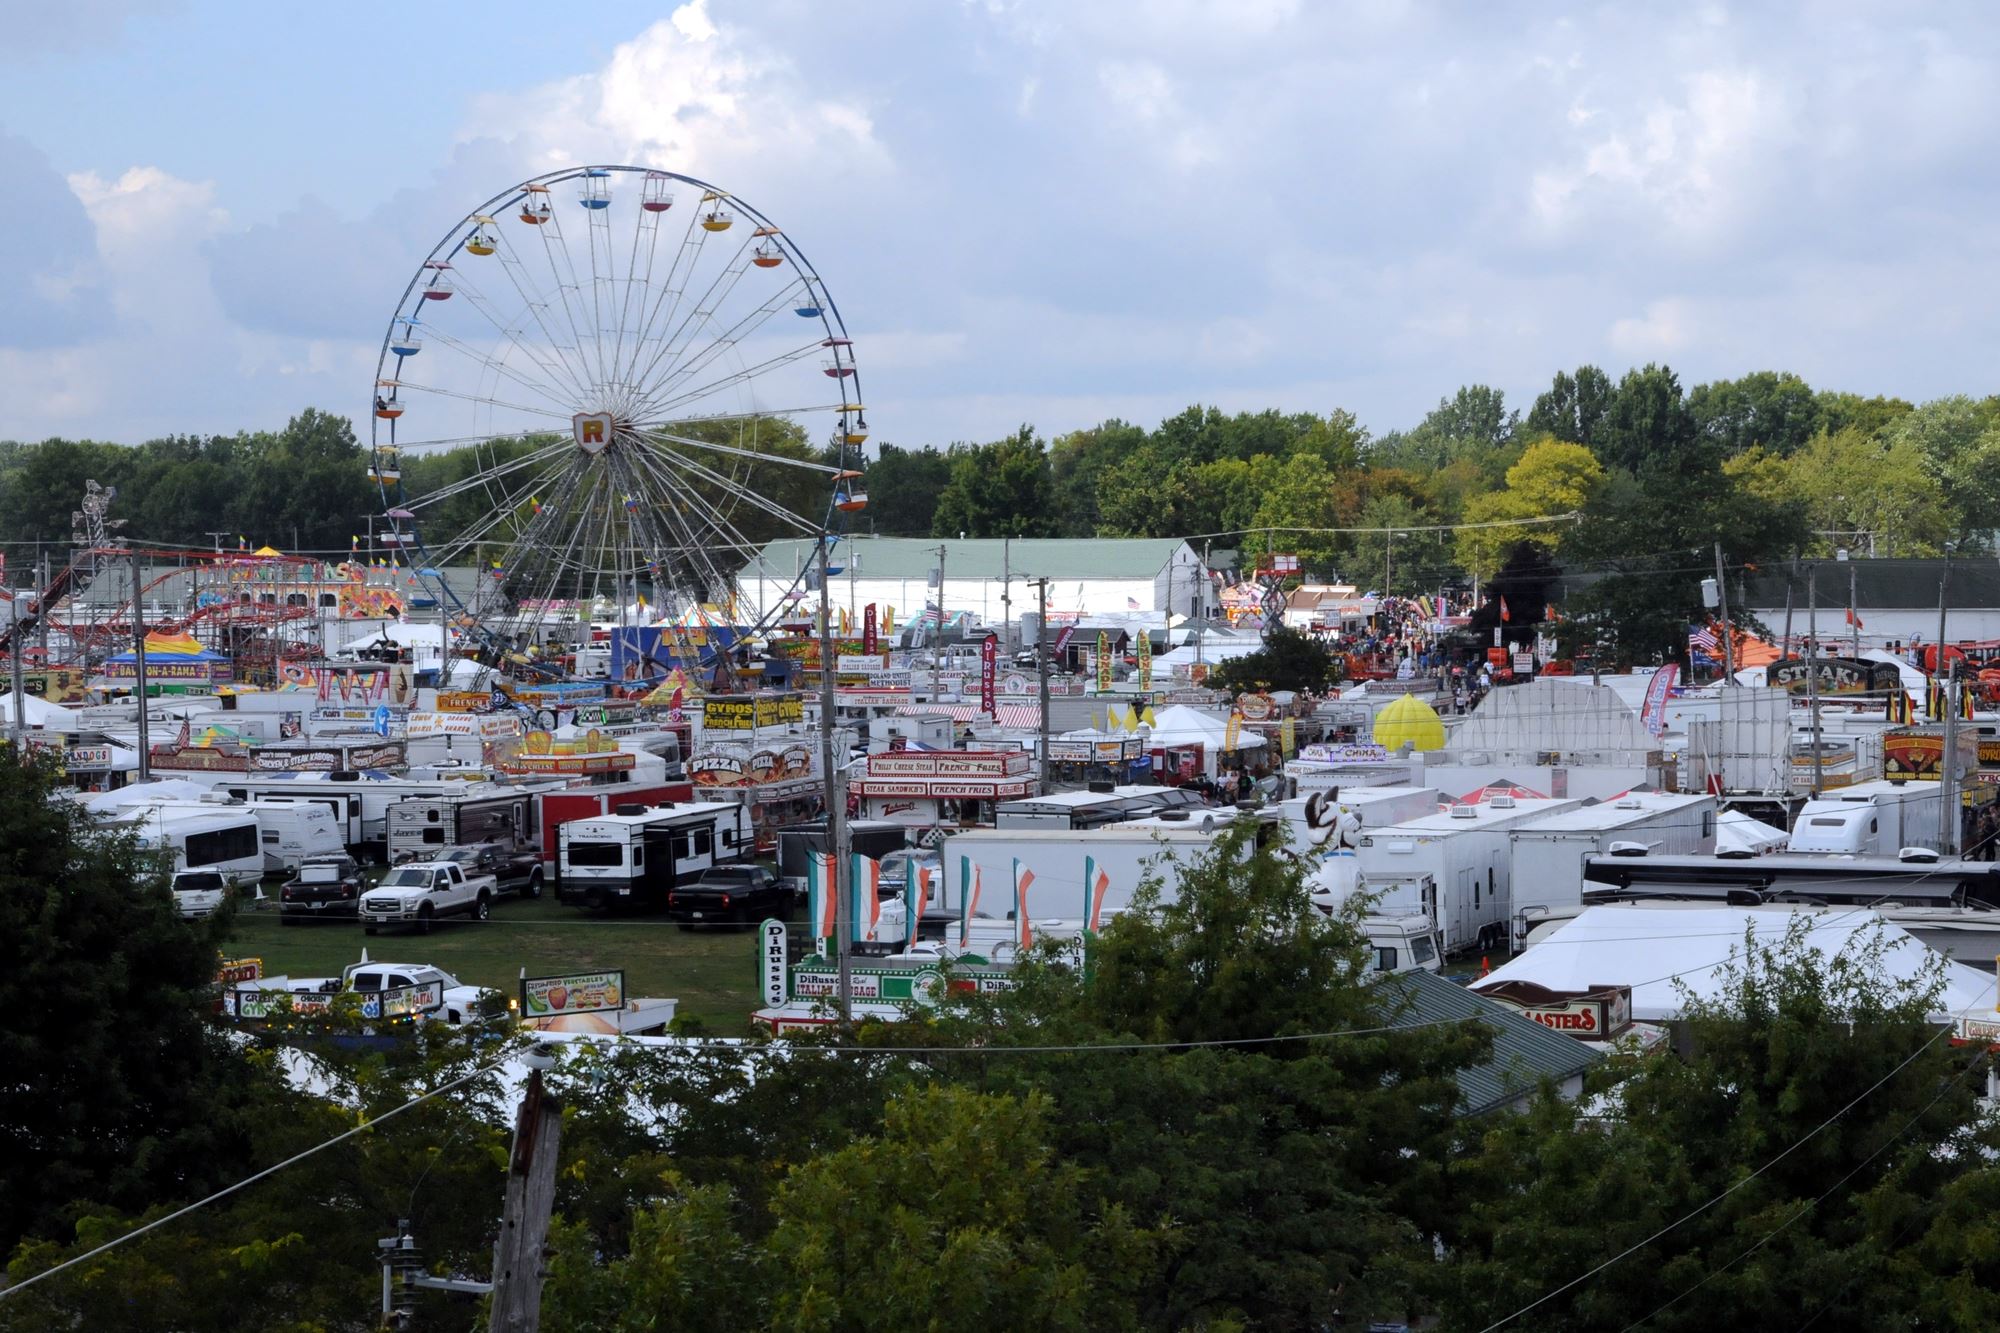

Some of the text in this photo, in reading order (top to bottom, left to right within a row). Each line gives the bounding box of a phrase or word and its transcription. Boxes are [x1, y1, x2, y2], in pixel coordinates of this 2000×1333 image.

[583, 420, 604, 443] R
[120, 664, 196, 676] BALON-A-RAMA
[706, 703, 753, 713] GYROS
[290, 754, 309, 766] STEAK
[692, 758, 742, 774] PIZZA
[752, 755, 774, 771] PIZZA
[874, 762, 933, 770] PHILLY CHEESE STEAK
[938, 762, 1001, 772] FRENCH FRIES
[866, 785, 885, 793] STEAK
[768, 926, 783, 1003] DiRusso's
[562, 975, 604, 986] VEGETABLES
[384, 991, 403, 1001] GREEK
[1525, 1008, 1596, 1031] ASTERS
